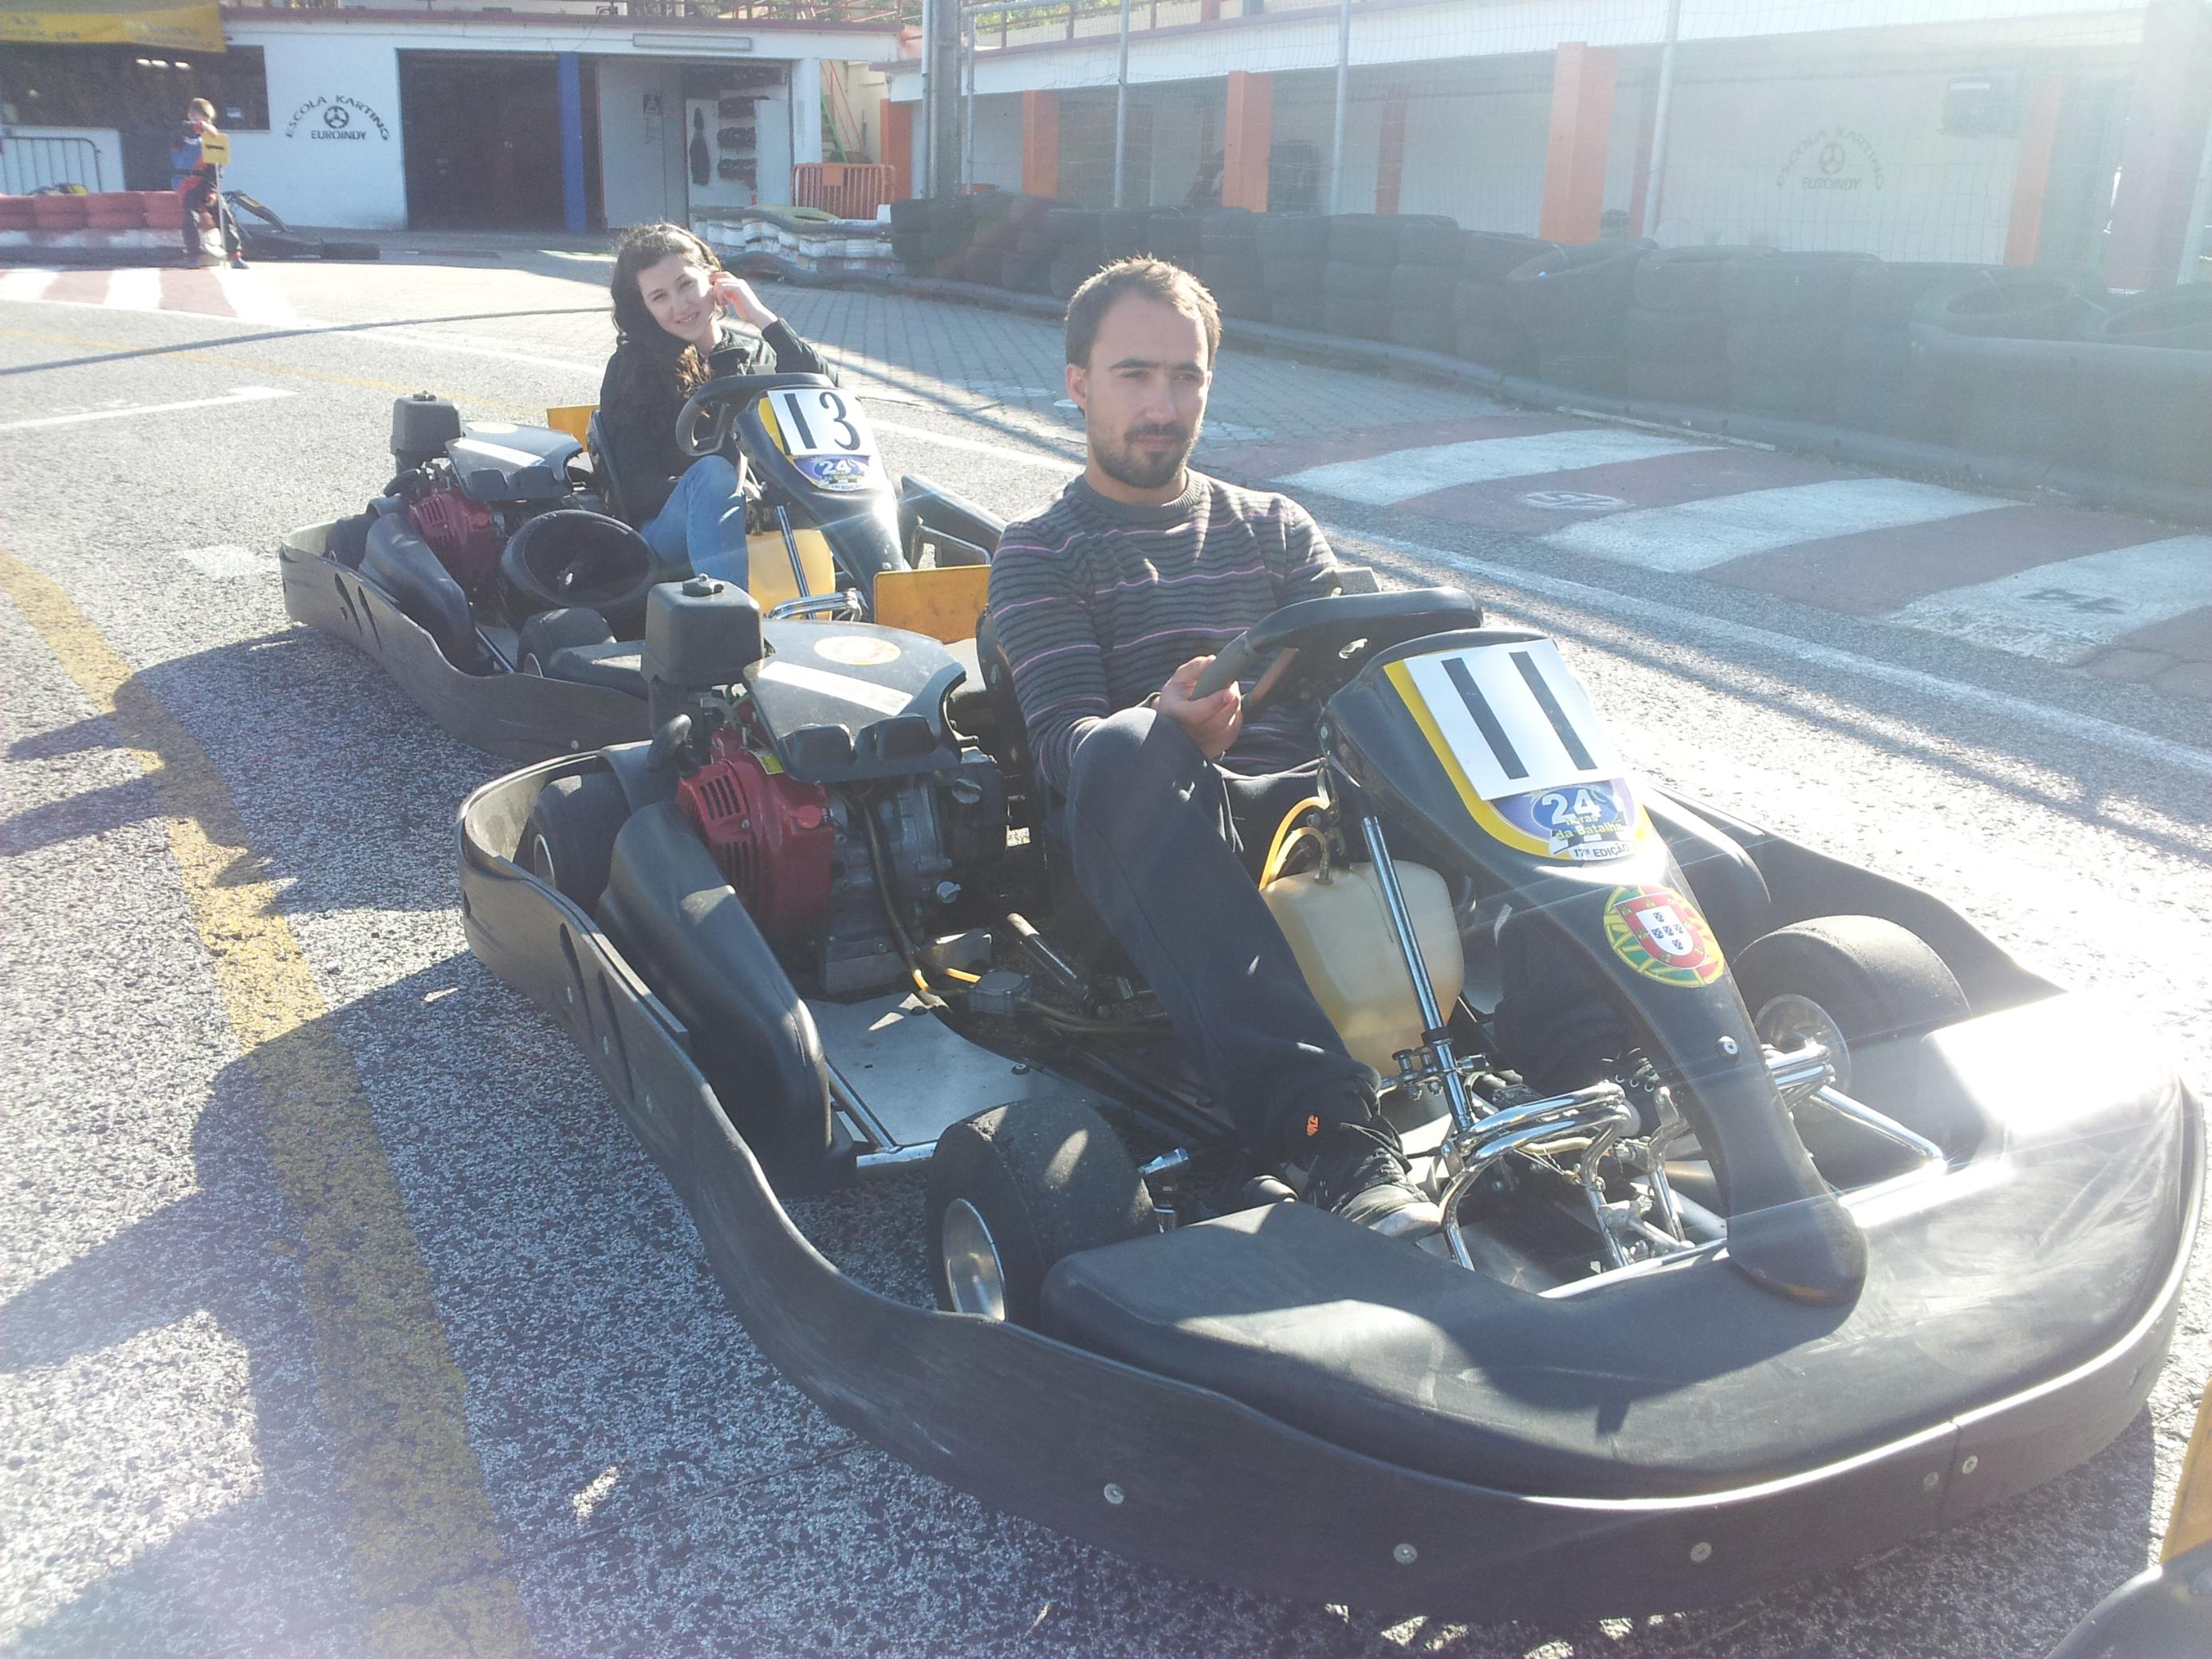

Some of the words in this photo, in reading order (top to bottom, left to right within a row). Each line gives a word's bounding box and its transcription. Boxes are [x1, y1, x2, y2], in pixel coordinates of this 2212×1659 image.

[285, 96, 327, 139] ESCOLA
[336, 94, 390, 140] KARTING
[311, 130, 367, 140] EUROINDY
[784, 392, 861, 451] 13
[819, 459, 852, 475] 24
[1440, 651, 1598, 780] 11
[1541, 789, 1602, 825] 24
[1555, 829, 1574, 841] da
[1576, 821, 1625, 836] Batalha
[1594, 843, 1630, 858] EDIÇÃO
